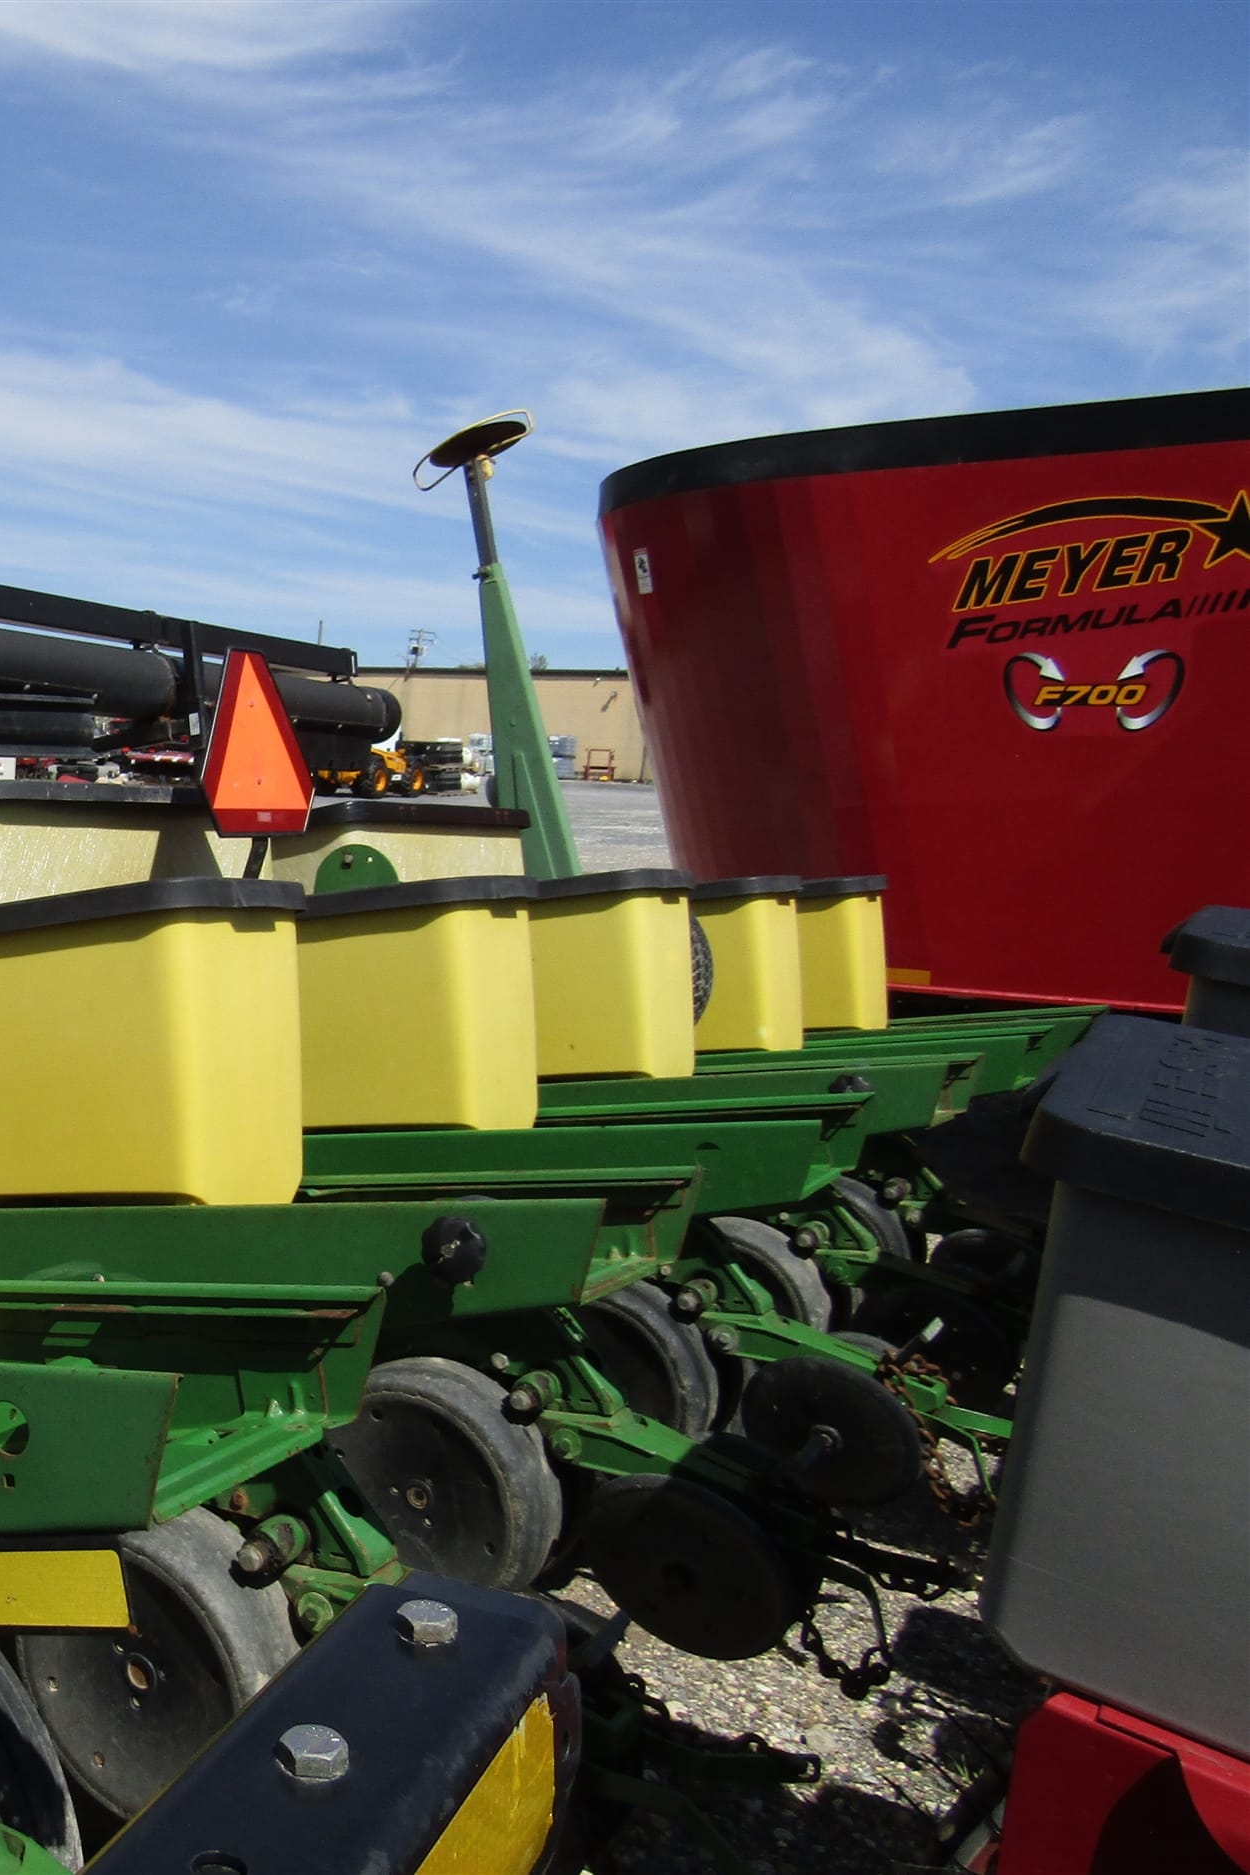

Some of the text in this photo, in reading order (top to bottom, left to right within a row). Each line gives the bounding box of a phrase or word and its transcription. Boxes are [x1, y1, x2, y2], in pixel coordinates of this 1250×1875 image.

[952, 527, 1193, 612] MEYER
[946, 597, 1182, 650] FORMULA
[1033, 683, 1148, 706] F700
